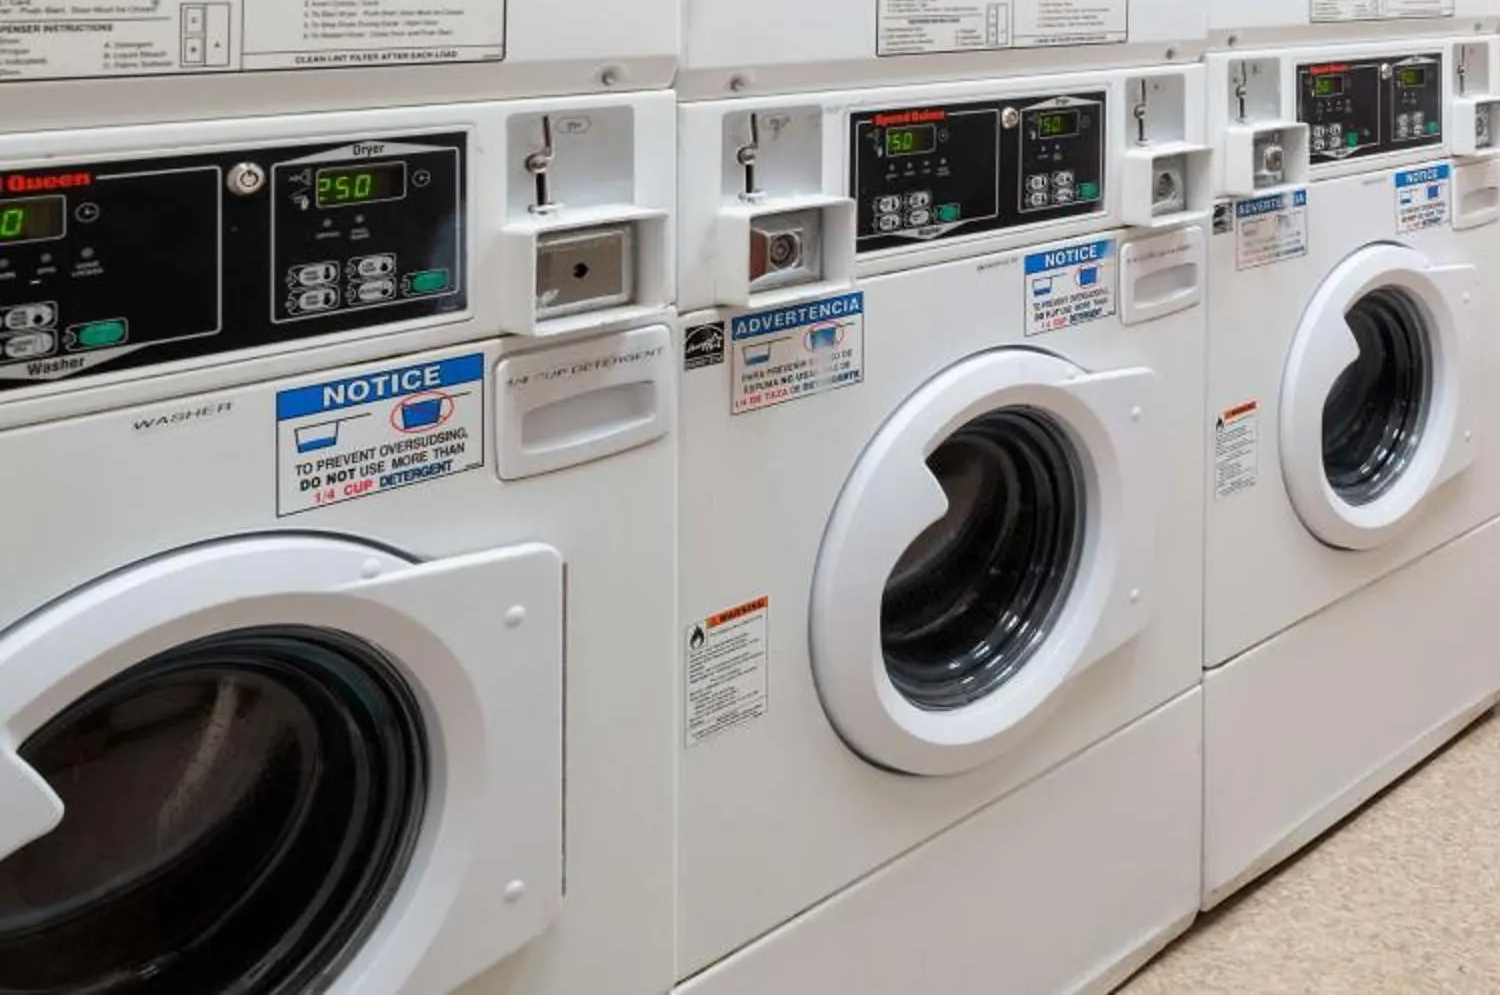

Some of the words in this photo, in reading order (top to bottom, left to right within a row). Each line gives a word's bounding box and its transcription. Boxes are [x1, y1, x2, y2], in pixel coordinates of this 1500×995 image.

[353, 144, 385, 157] Dryer
[7, 172, 91, 192] Queen
[1045, 244, 1097, 267] NOTICE
[736, 297, 860, 335] ADVERTENCIA
[27, 357, 85, 376] Washer
[322, 364, 441, 406] NOTICE
[132, 401, 235, 431] WASHER
[295, 462, 313, 476] TO
[316, 448, 376, 471] PREVENT
[379, 427, 469, 458] OVERSUDSING,
[299, 477, 321, 492] DO
[326, 468, 356, 485] NOT
[359, 461, 386, 478] USE
[391, 450, 428, 469] MORE
[433, 442, 465, 459] THAN
[314, 489, 335, 503] 1/4
[343, 479, 373, 496] CUP
[379, 460, 454, 487] DETERGENT
